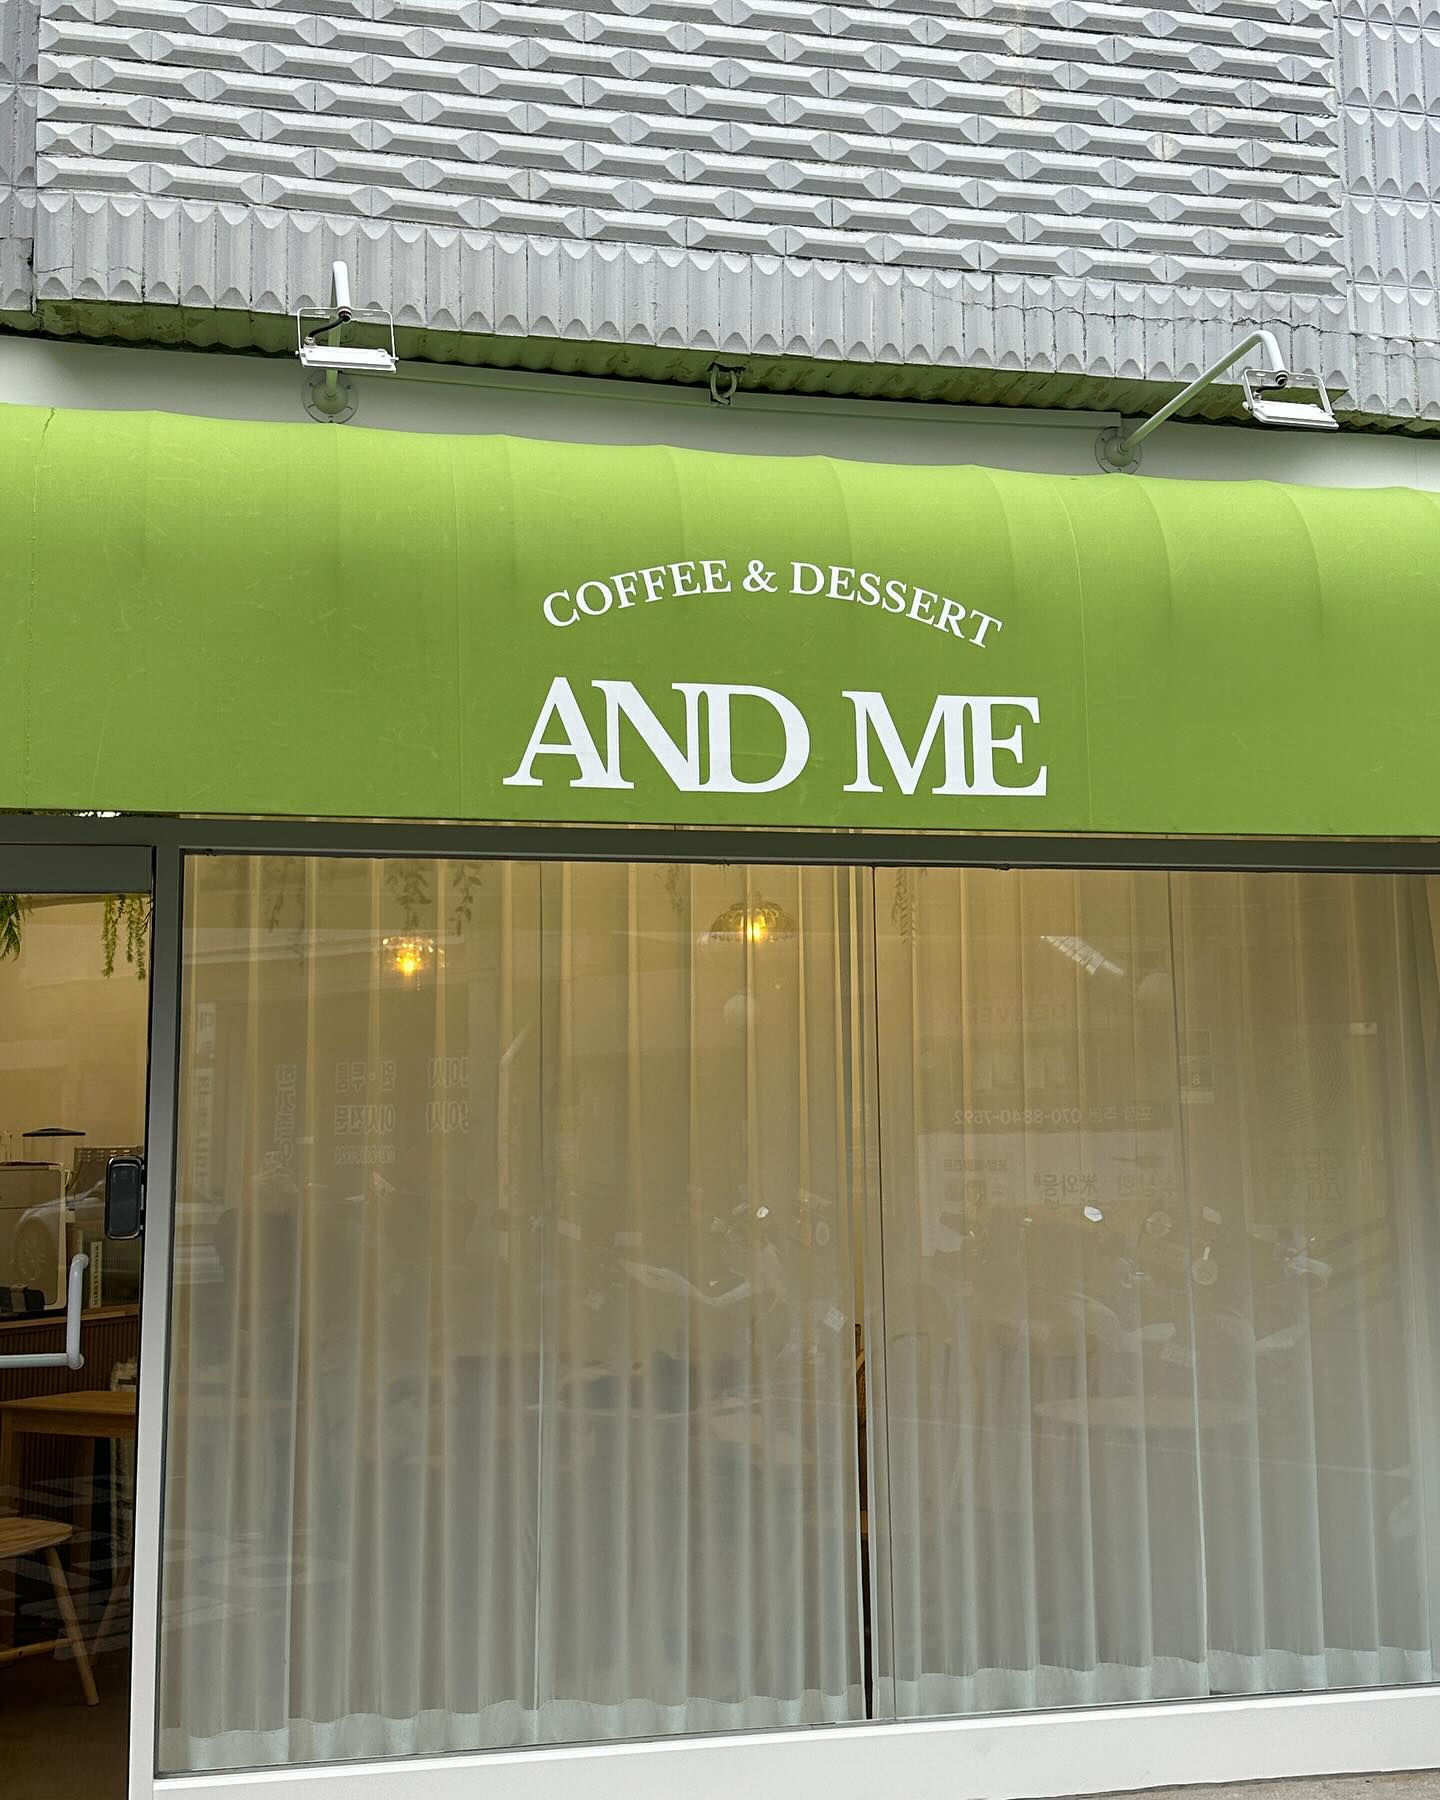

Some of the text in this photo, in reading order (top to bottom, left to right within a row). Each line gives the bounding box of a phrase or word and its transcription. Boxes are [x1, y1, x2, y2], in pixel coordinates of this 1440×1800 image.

[544, 560, 1002, 648] COFFEE & DESSERT
[503, 677, 1048, 797] AND ME
